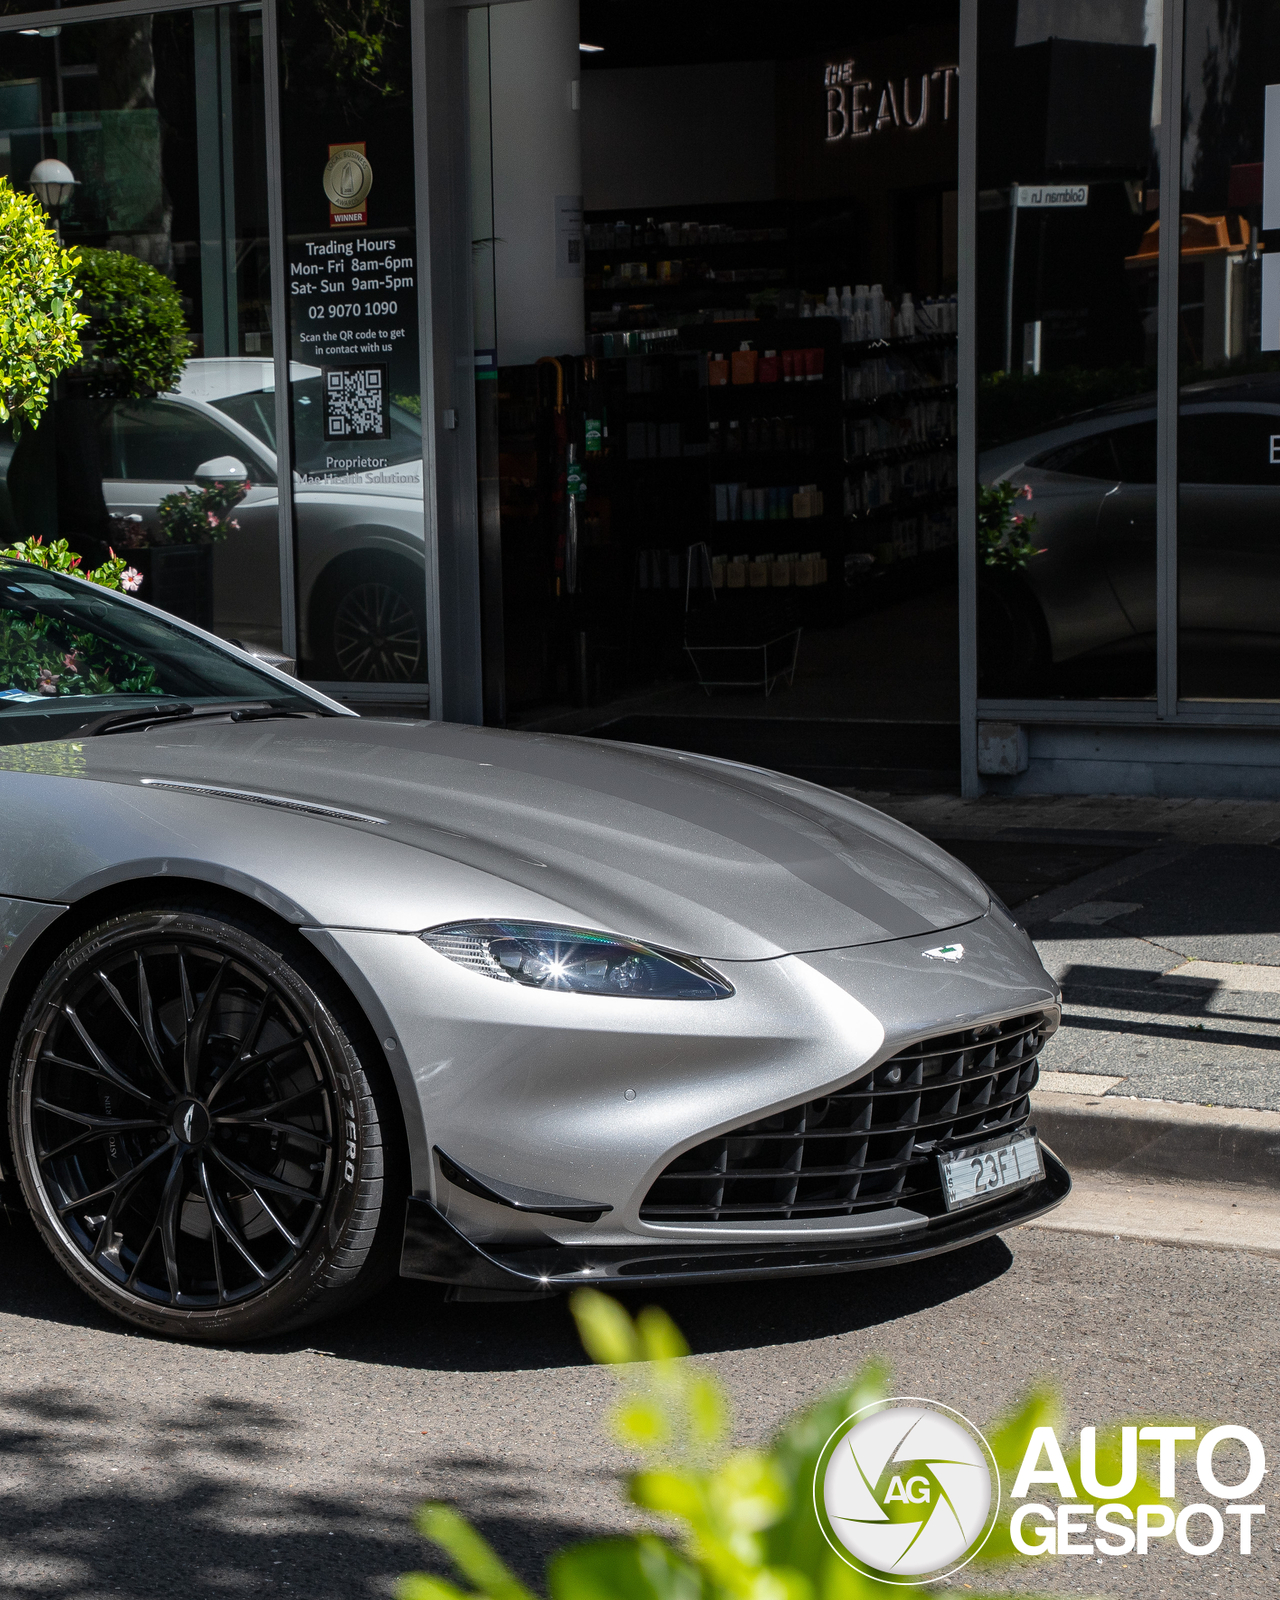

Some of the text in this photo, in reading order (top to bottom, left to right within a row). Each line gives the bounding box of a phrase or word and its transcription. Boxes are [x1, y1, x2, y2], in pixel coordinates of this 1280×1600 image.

[824, 59, 855, 86] THE
[824, 65, 959, 142] BEAUT
[327, 151, 368, 171] LOCAL BUSINESS
[334, 213, 363, 222] WINNER
[305, 238, 396, 256] Trading Hours
[290, 256, 413, 276] Mon- Fri 8am-6pm
[291, 275, 413, 295] Sat- Sun 9am-5pm
[308, 301, 398, 319] 02 9070 1090
[300, 328, 405, 342] Scan the QR code to get
[315, 342, 393, 355] in contact with us
[326, 456, 388, 470] Proprietor:
[297, 472, 420, 485] Mae Health Solutions
[104, 1095, 112, 1115] RTIN
[109, 1136, 117, 1158] ASTO
[342, 1097, 357, 1184] ZERO
[970, 1146, 1021, 1193] 23F1
